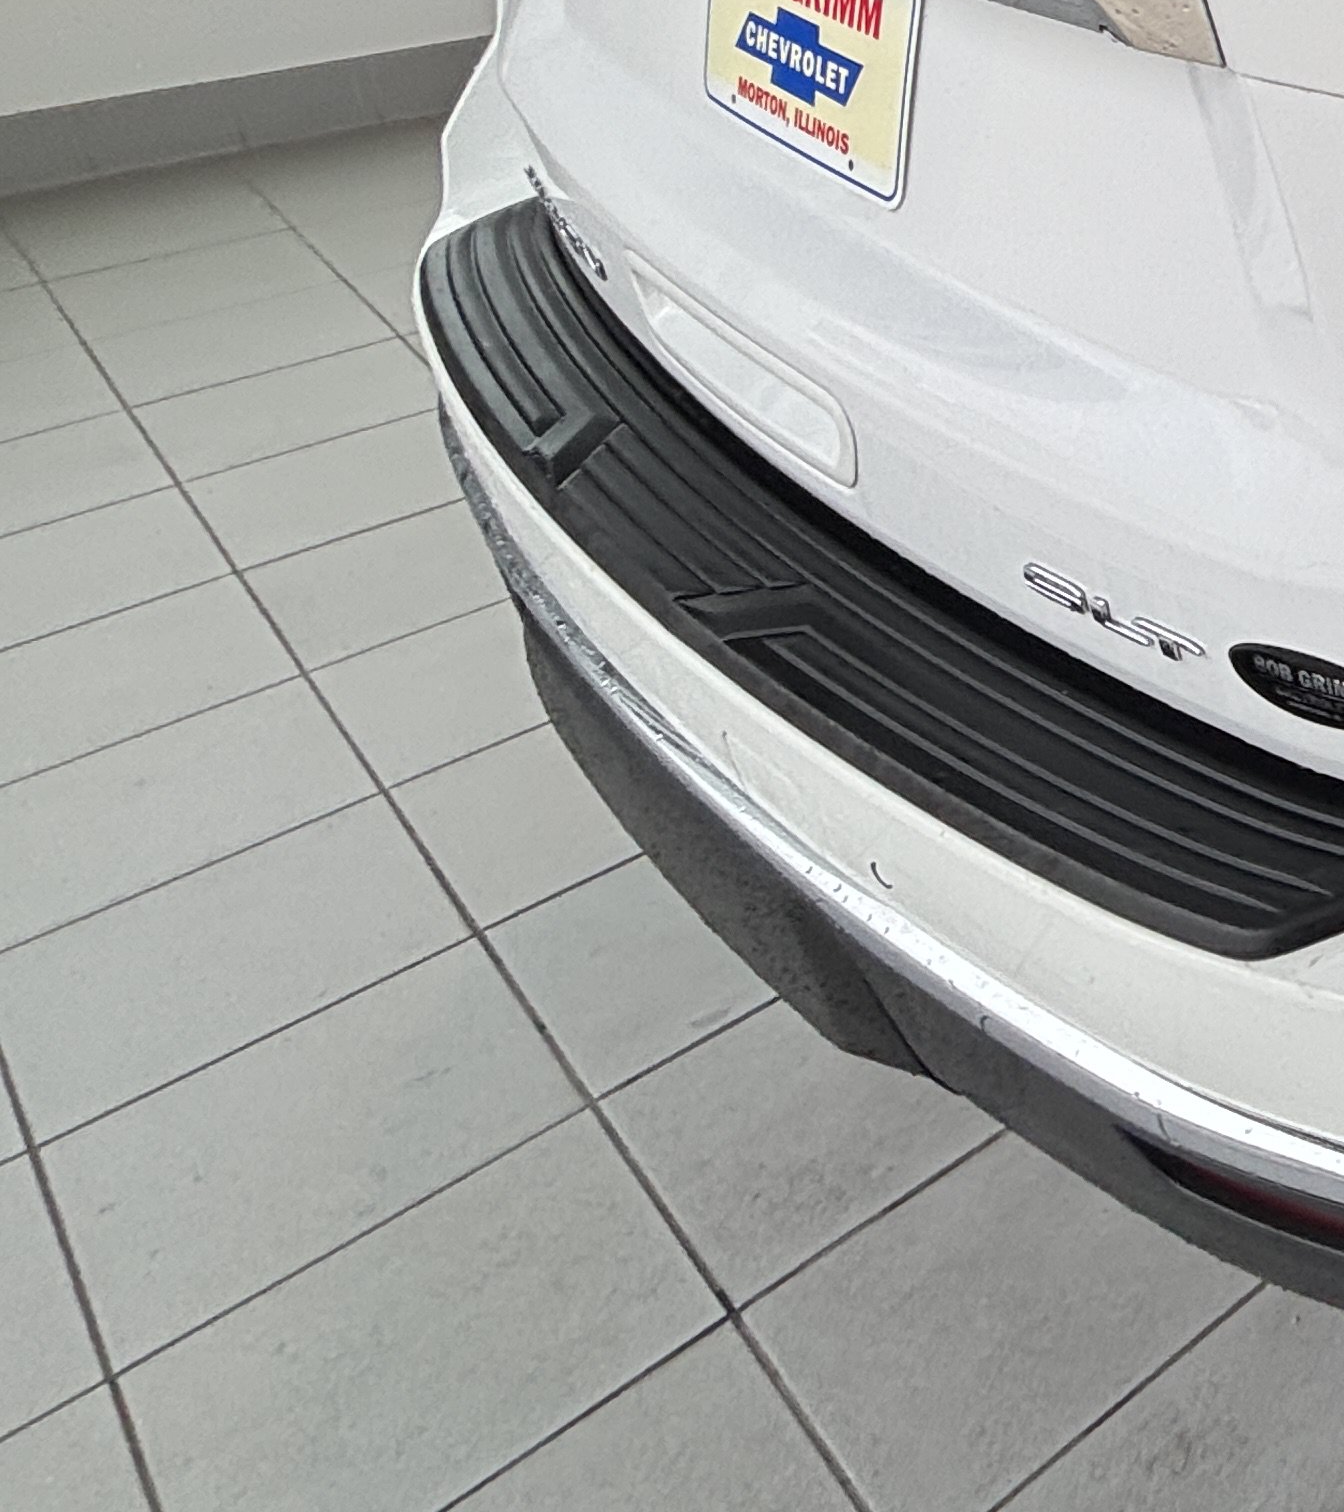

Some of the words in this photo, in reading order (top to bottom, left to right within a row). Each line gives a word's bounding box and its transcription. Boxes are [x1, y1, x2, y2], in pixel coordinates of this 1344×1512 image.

[745, 20, 849, 95] CHEVROLET
[737, 75, 790, 127] MORTON,
[794, 110, 850, 155] ILLINOIS
[1023, 561, 1206, 661] SLT
[1253, 654, 1293, 683] BOB
